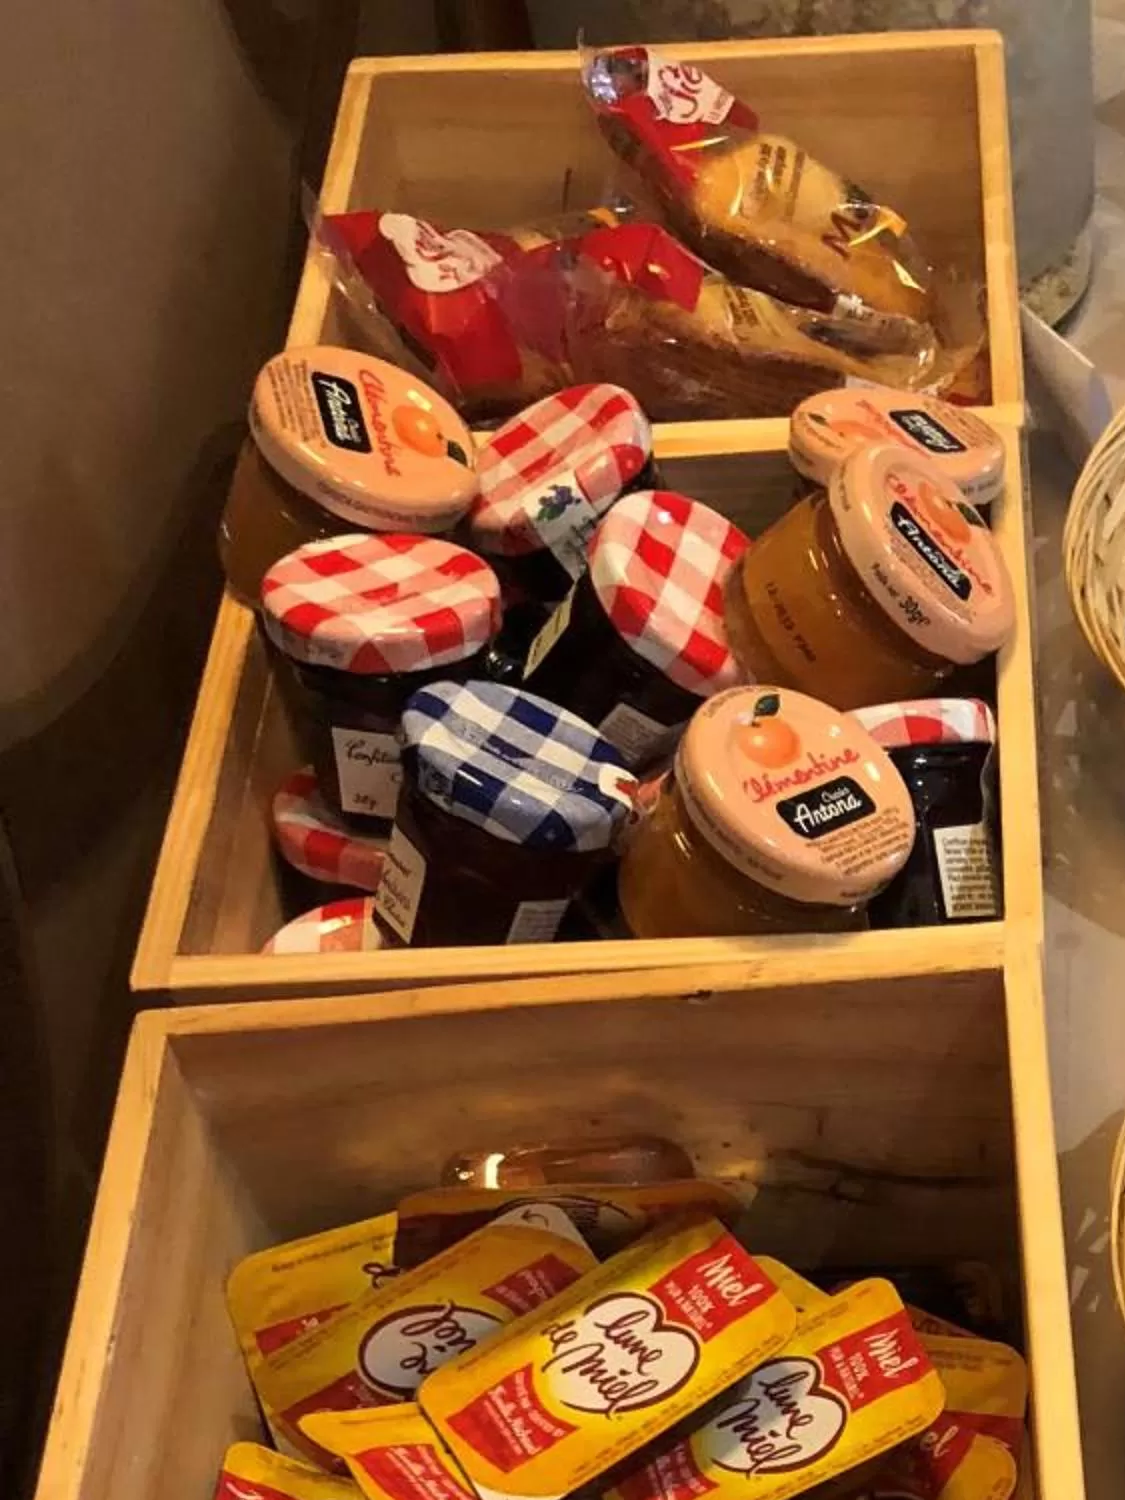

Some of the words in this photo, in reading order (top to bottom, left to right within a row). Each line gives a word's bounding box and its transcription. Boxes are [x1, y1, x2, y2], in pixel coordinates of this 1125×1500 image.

[794, 790, 862, 833] Antona
[697, 1254, 764, 1308] Miel
[865, 1328, 919, 1380] Miel
